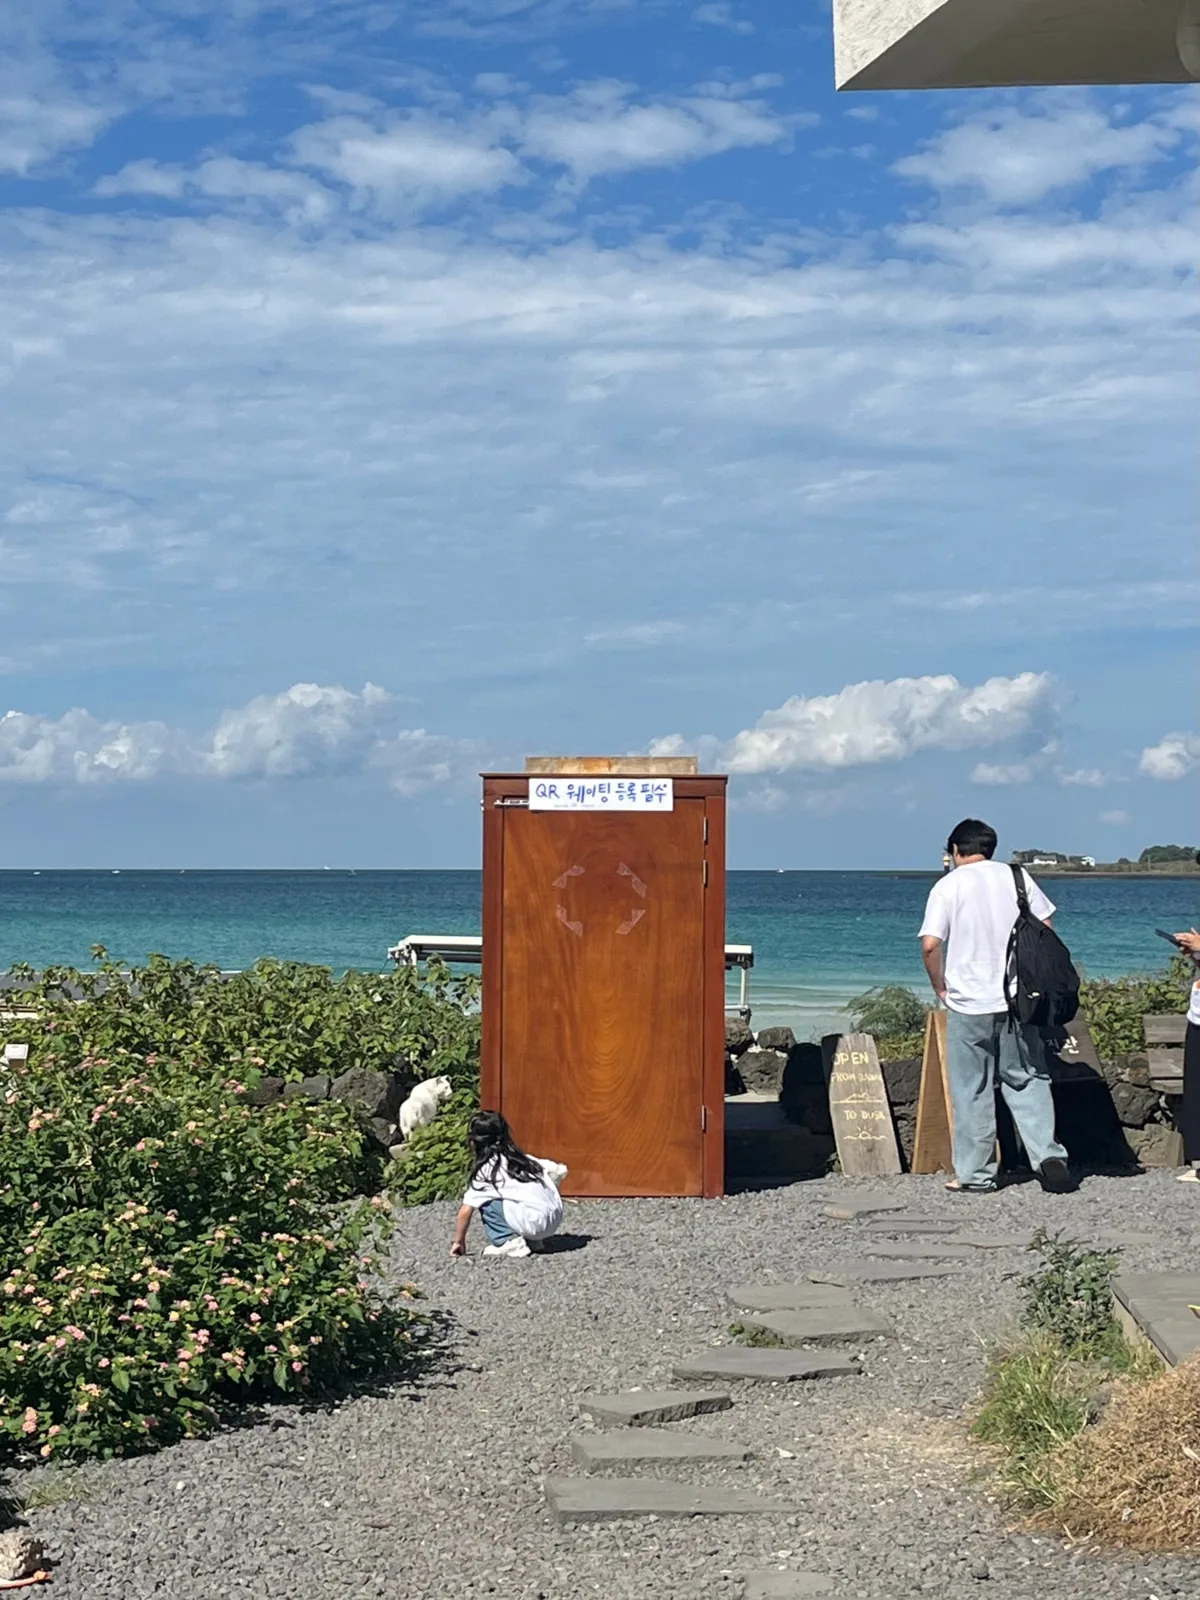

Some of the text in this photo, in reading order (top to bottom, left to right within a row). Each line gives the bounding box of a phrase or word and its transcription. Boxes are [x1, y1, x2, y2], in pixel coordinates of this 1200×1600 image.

[535, 782, 668, 804] QR 웨이팅 등록 필수
[832, 1051, 869, 1065] OPEN
[830, 1072, 856, 1083] FROM
[843, 1109, 886, 1120] TO DUSK
